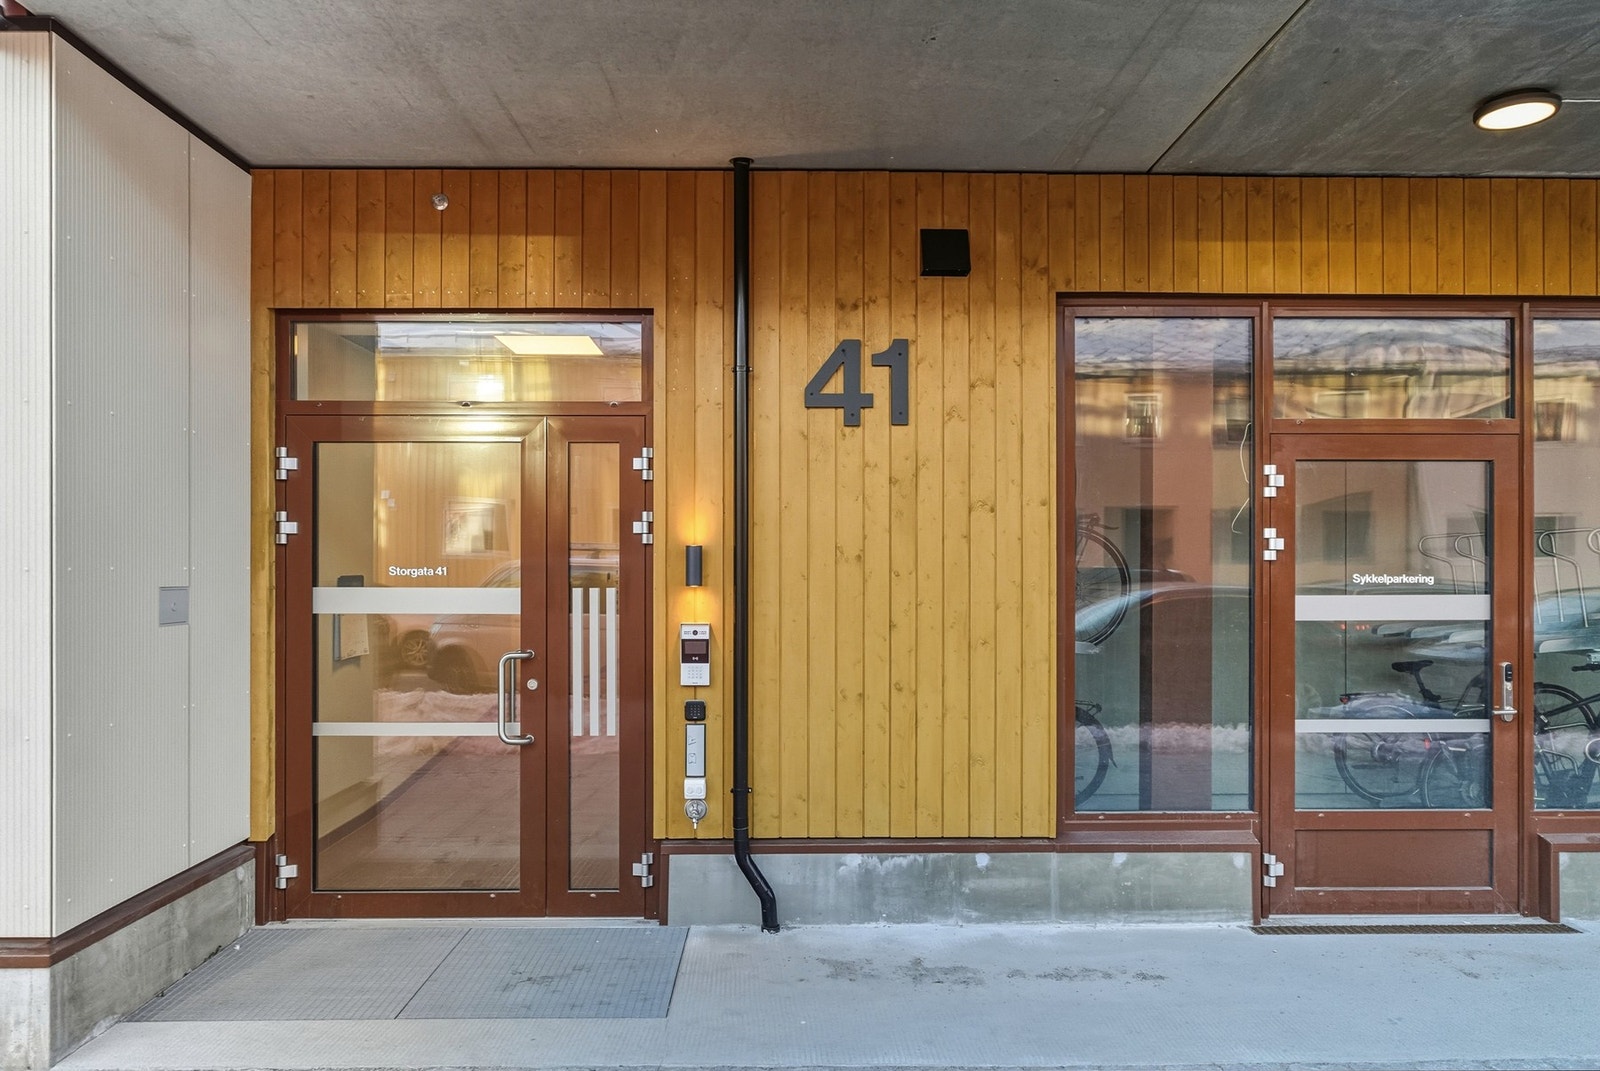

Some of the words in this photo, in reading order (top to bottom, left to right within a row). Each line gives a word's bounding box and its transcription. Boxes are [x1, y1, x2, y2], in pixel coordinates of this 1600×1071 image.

[805, 339, 909, 427] 41
[388, 566, 434, 578] Storgata
[435, 566, 447, 576] 41
[1352, 573, 1435, 586] Sykkelparkering
